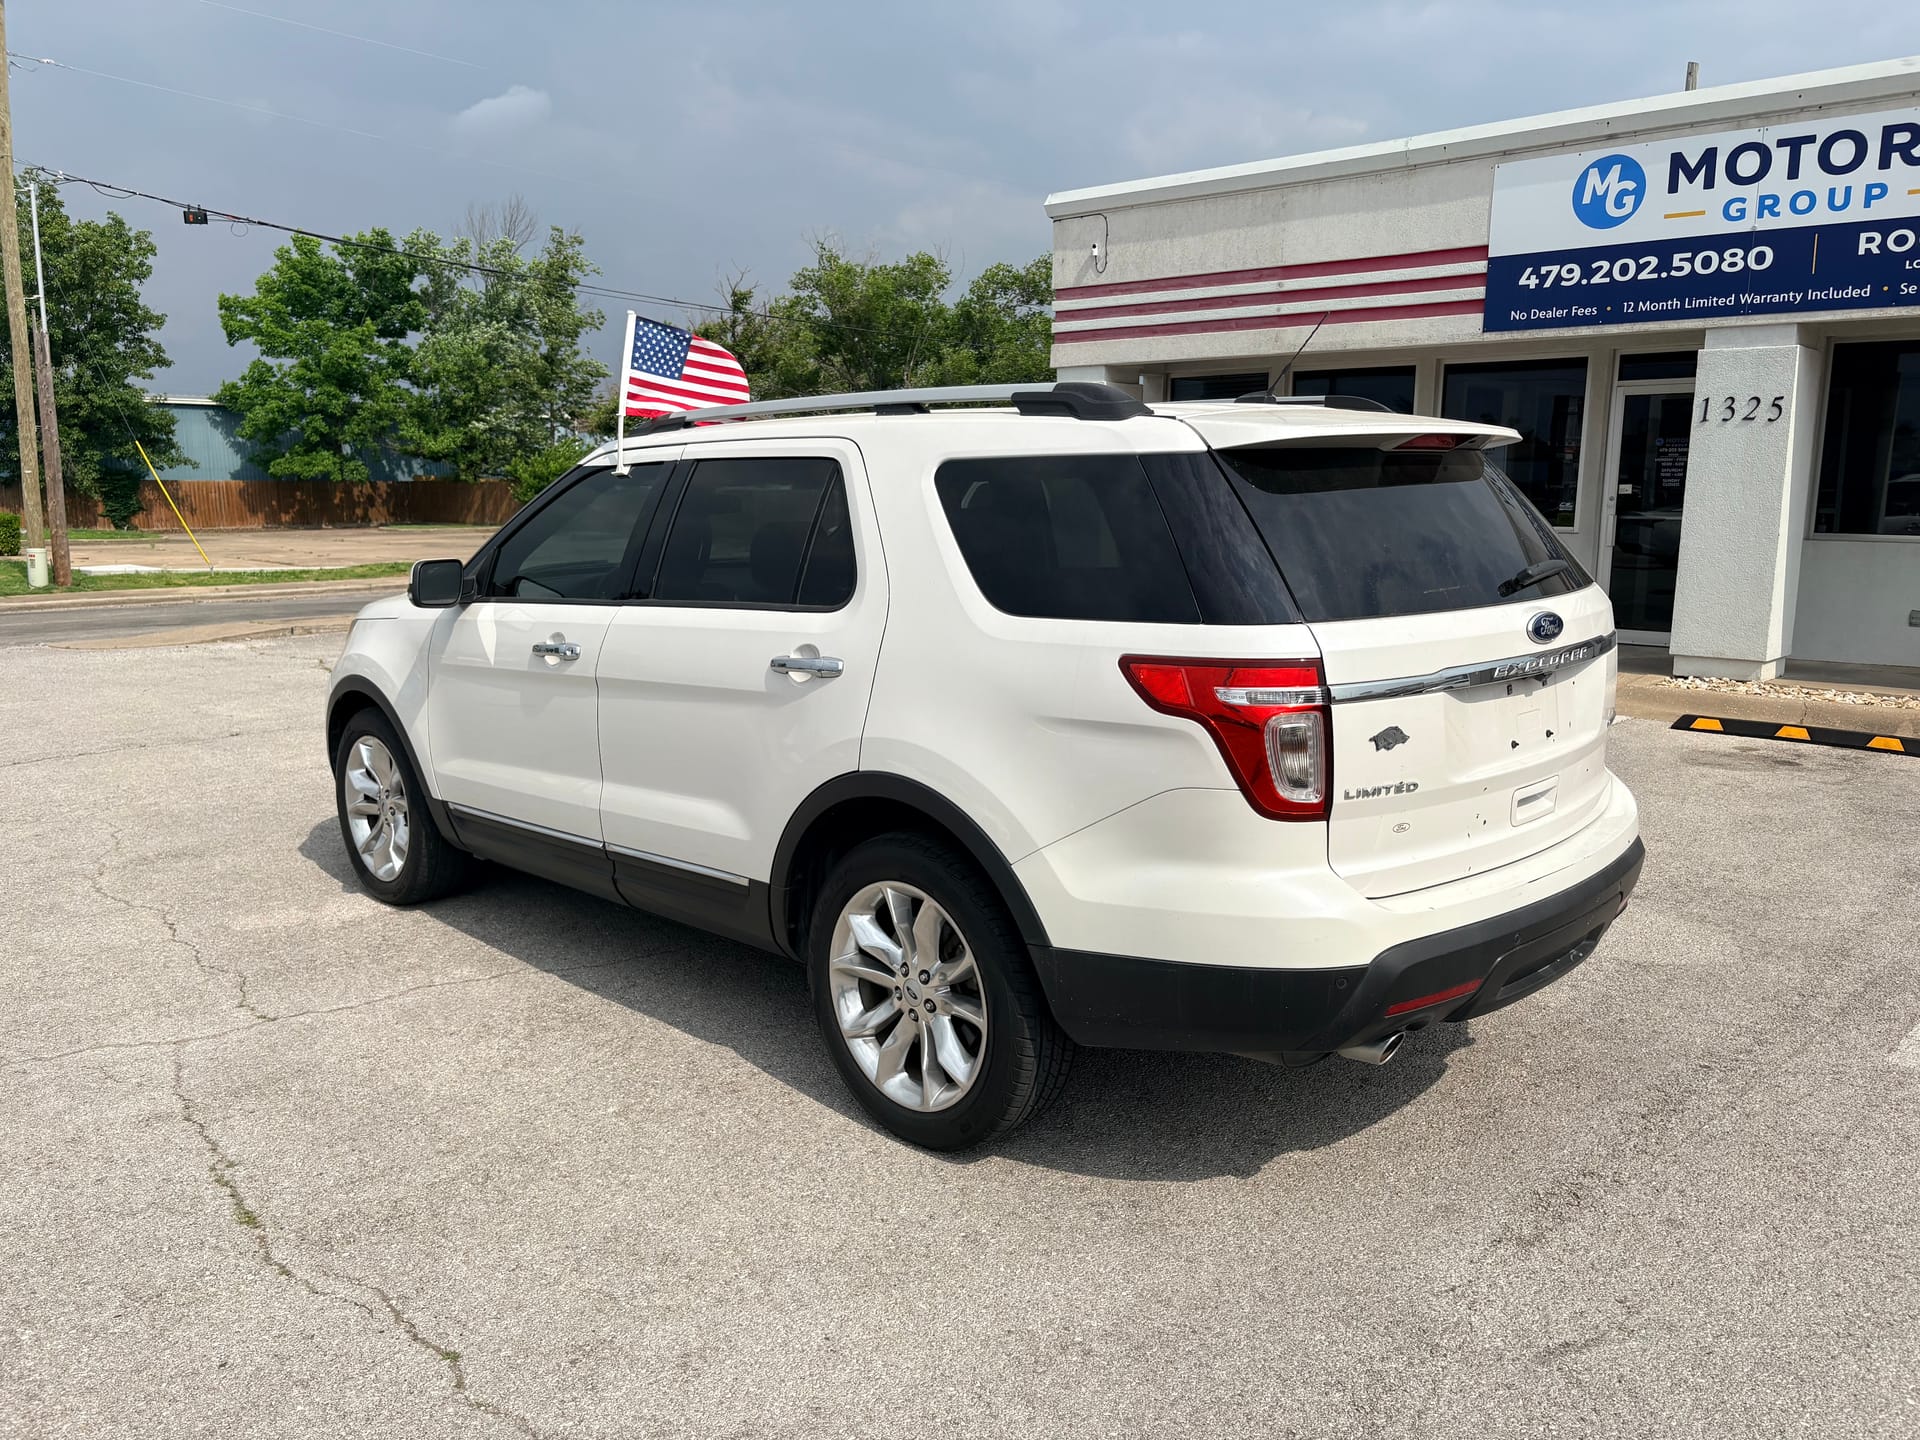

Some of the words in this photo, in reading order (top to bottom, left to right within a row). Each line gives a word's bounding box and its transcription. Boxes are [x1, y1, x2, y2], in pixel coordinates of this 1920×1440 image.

[1667, 122, 1920, 195] MOTOR
[1582, 164, 1637, 217] MG
[1722, 182, 1889, 222] GROUP
[1857, 228, 1920, 256] RO
[1518, 245, 1774, 290] 479.202.5080
[1510, 310, 1527, 321] No
[1531, 306, 1569, 319] Dealer
[1571, 305, 1598, 317] Fees
[1623, 301, 1634, 313] 12
[1638, 298, 1681, 312] Month
[1684, 293, 1735, 309] Limited
[1739, 291, 1803, 305] Warranty
[1807, 284, 1871, 301] Included
[1899, 282, 1918, 295] Se
[1699, 395, 1785, 423] 1325
[1493, 646, 1588, 678] EXPLORER
